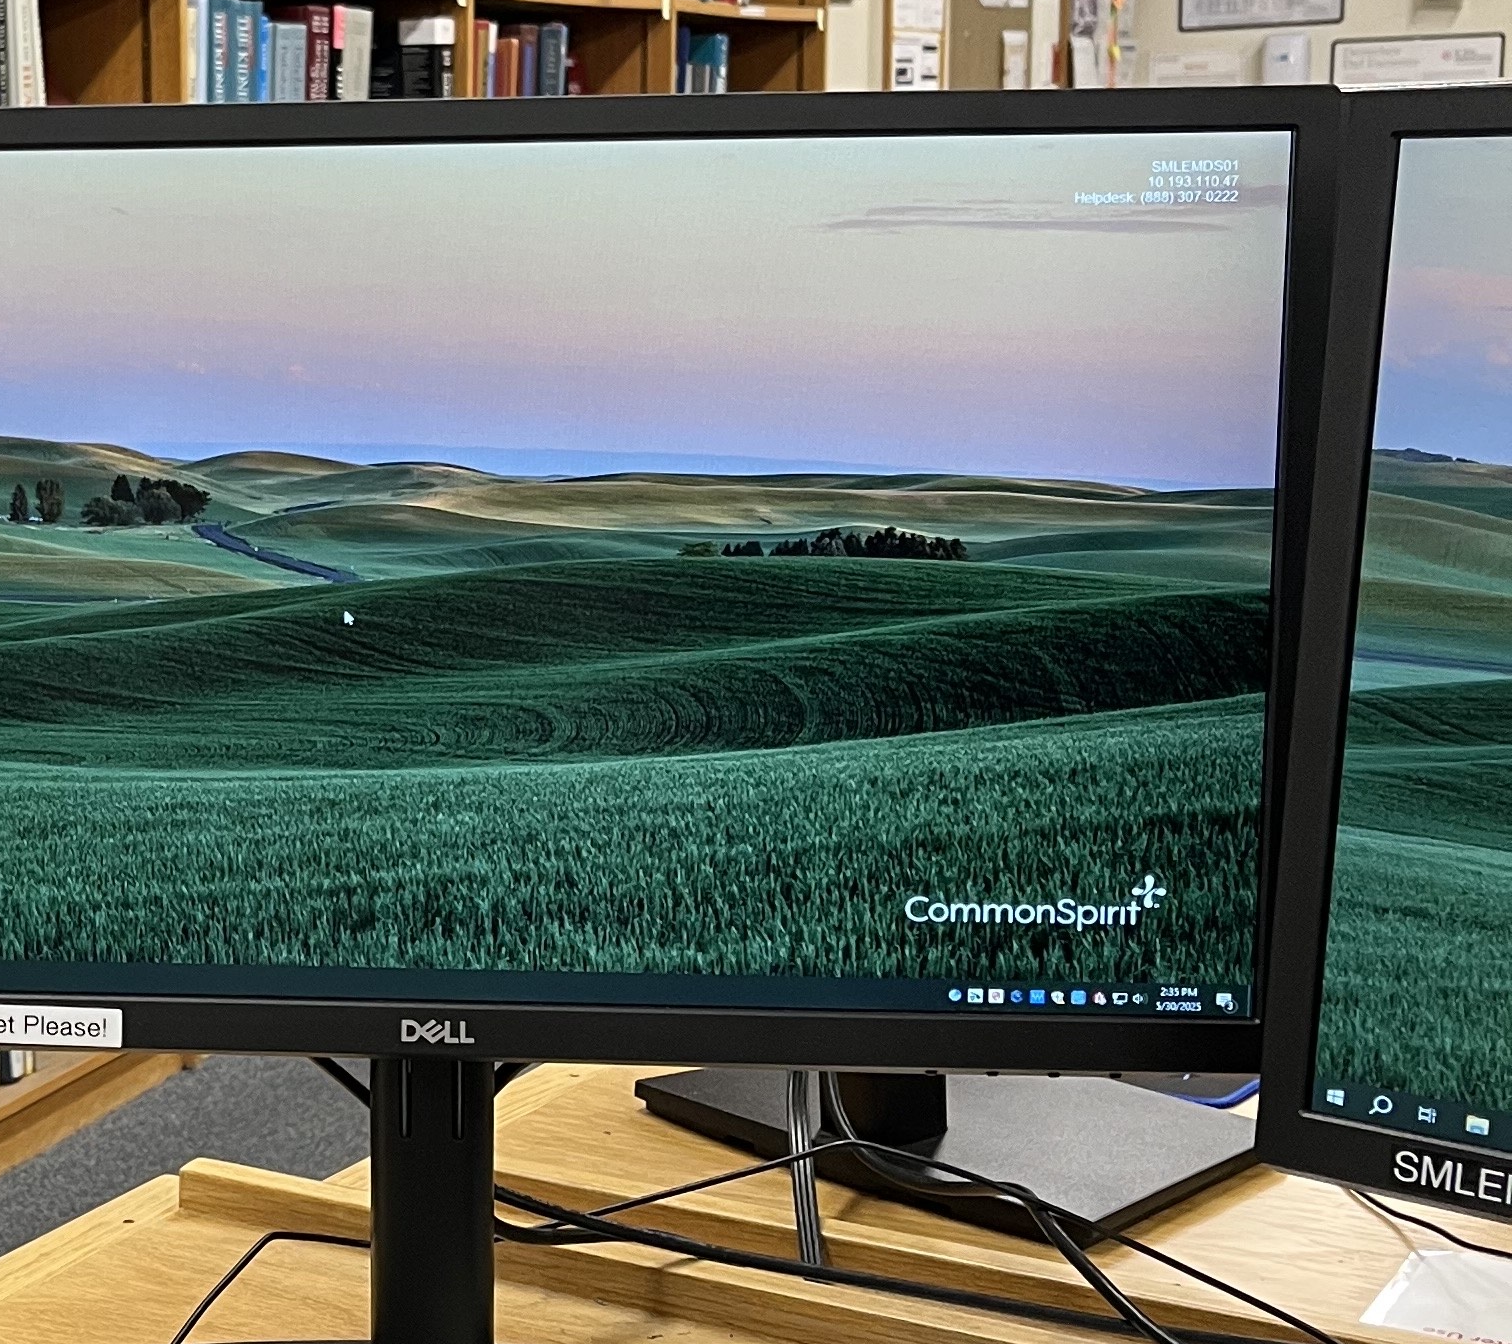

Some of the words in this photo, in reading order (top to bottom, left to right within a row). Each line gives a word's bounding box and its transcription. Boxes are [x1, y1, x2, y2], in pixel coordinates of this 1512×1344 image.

[1152, 160, 1239, 173] SMLEMDS01
[1140, 192, 1174, 205] (888)
[1178, 191, 1239, 203] 307-0222
[904, 895, 1141, 931] CommonSpirit
[1160, 987, 1179, 997] 2:35
[1181, 987, 1197, 997] PM
[1155, 1001, 1202, 1011] 5/30/2025
[24, 1016, 108, 1037] Please!
[401, 1019, 475, 1044] DELL
[1393, 1150, 1512, 1204] SMLE
